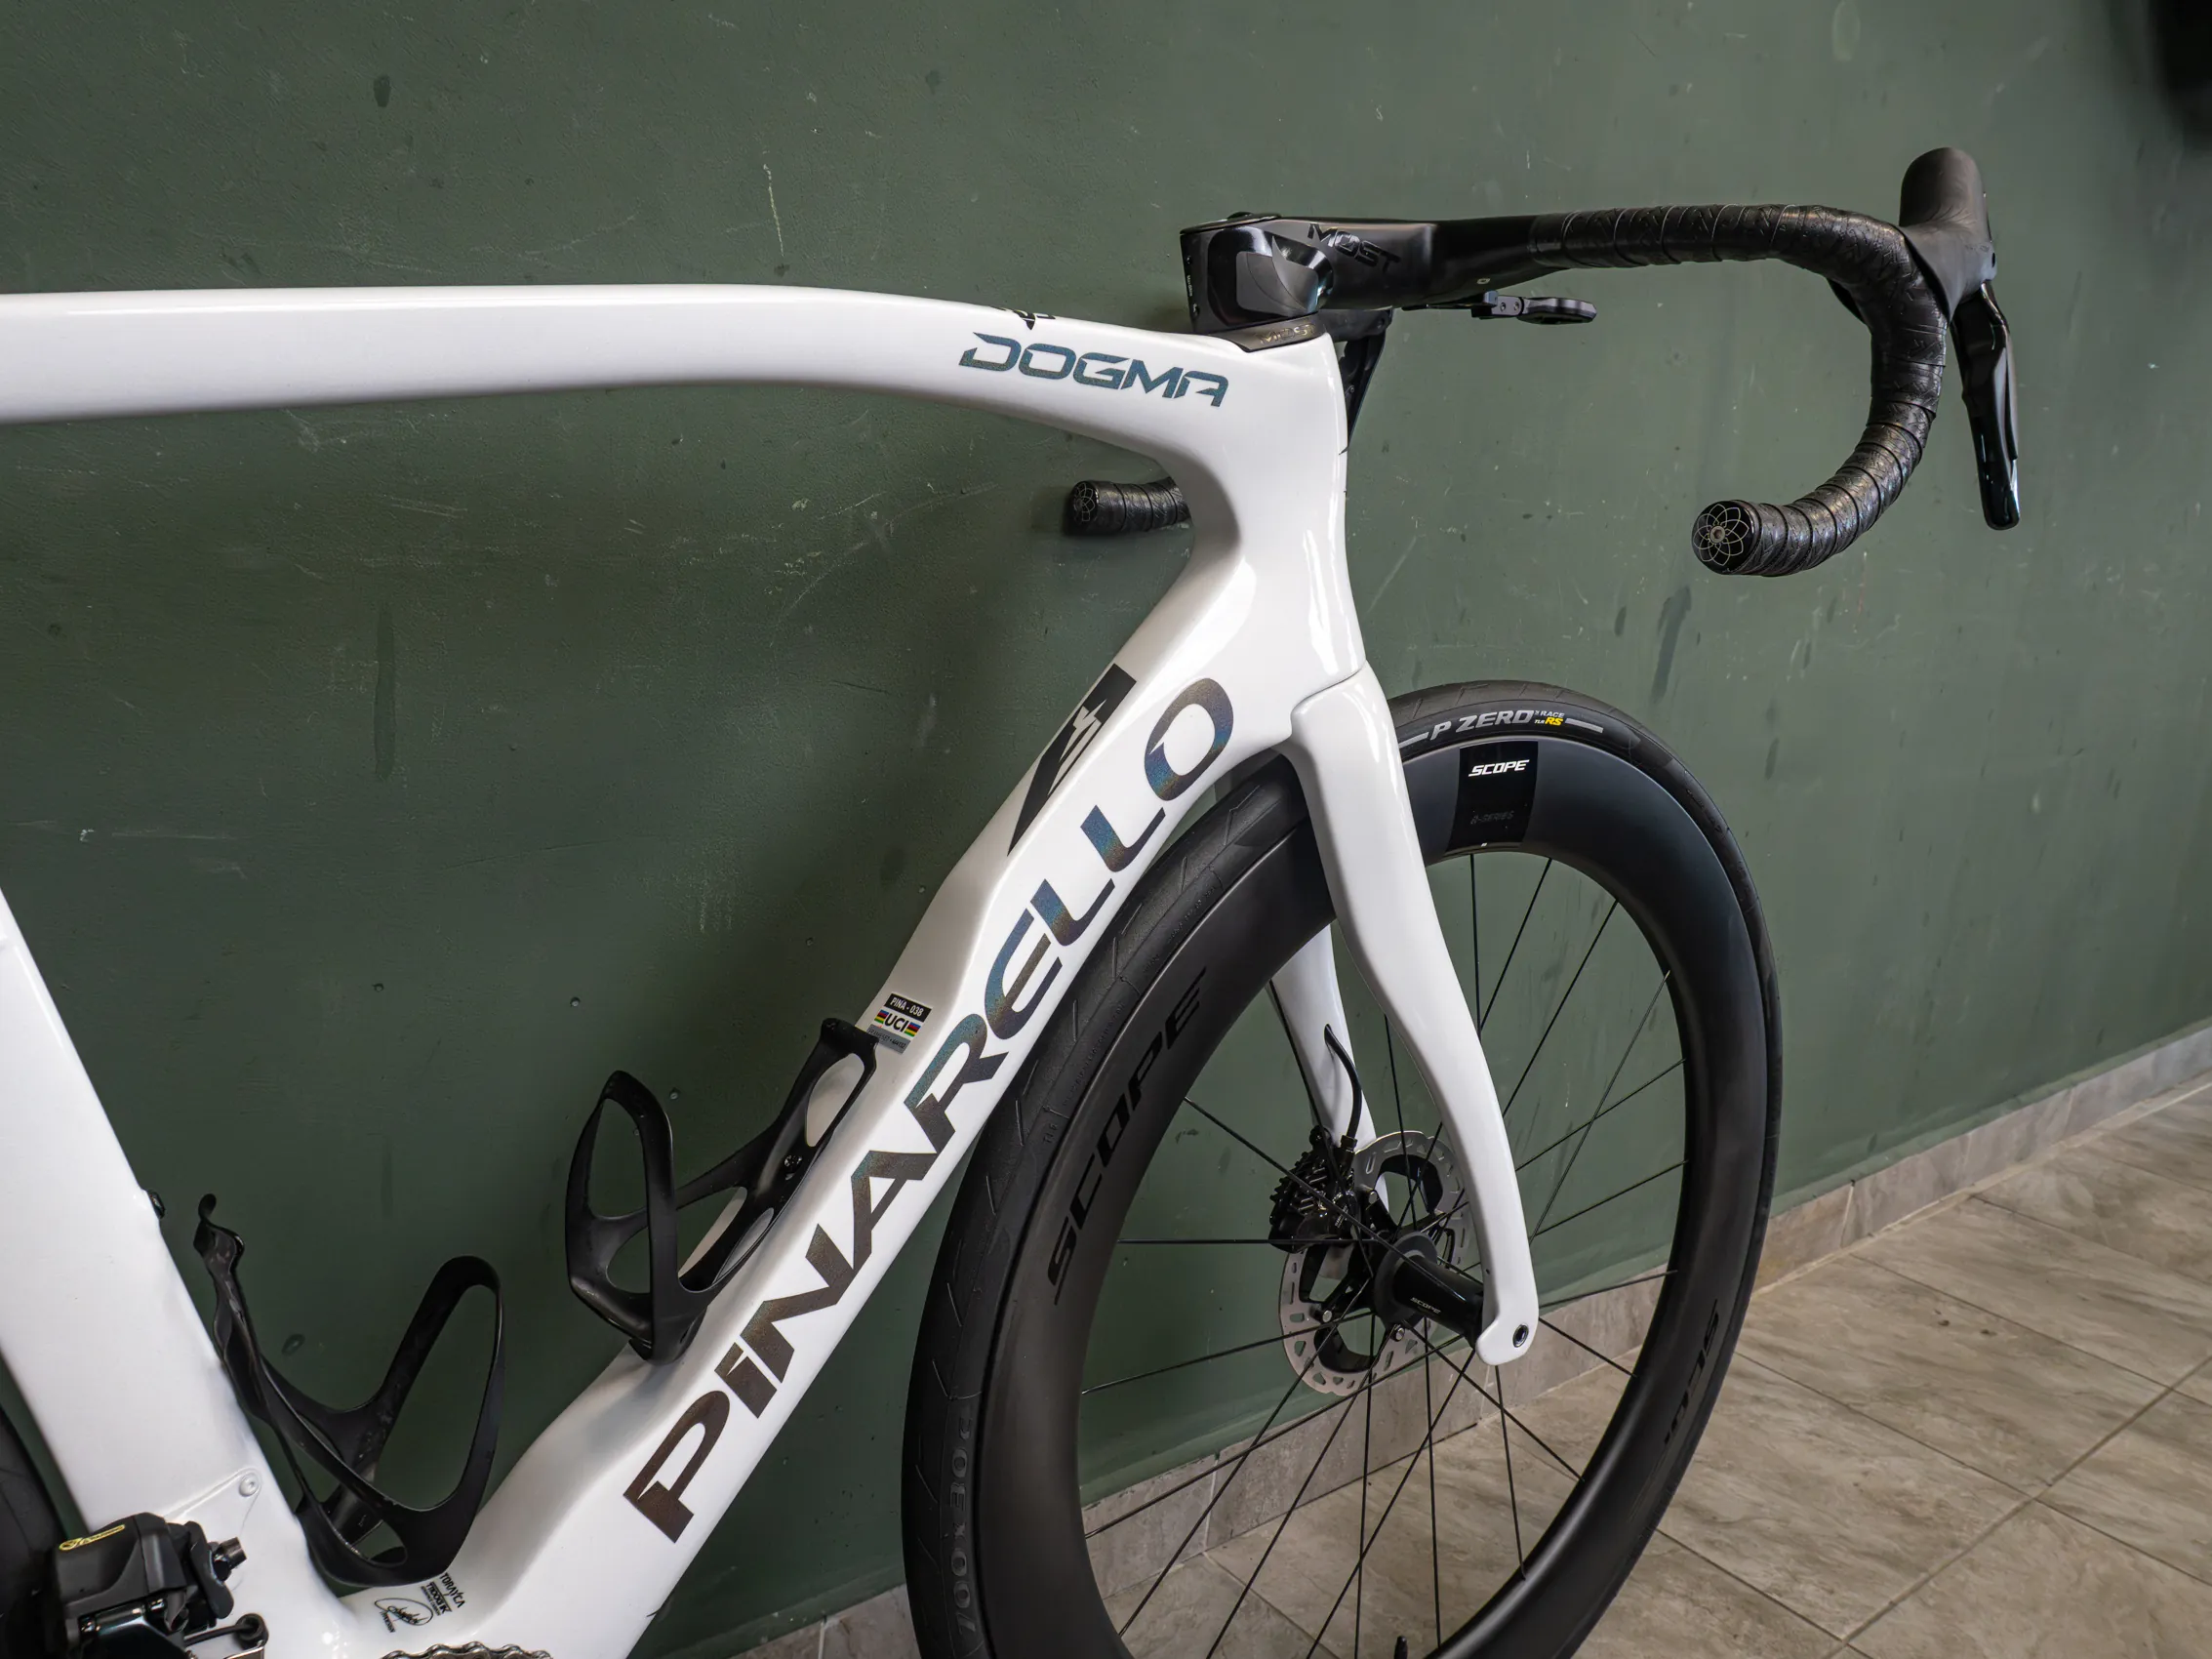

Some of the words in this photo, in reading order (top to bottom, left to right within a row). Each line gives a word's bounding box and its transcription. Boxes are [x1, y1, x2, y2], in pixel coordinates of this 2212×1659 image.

[1307, 223, 1400, 272] MOST
[1258, 323, 1318, 345] MOST
[959, 332, 1229, 407] DOGMA
[1429, 720, 1452, 741] P
[1456, 709, 1535, 733] ZERO
[1544, 716, 1564, 727] RS
[1468, 759, 1530, 778] SCOPE
[890, 996, 906, 1010] PINA
[884, 1013, 909, 1033] UCI
[1047, 966, 1207, 1306] SCOPE
[1410, 1295, 1442, 1315] SCOPE
